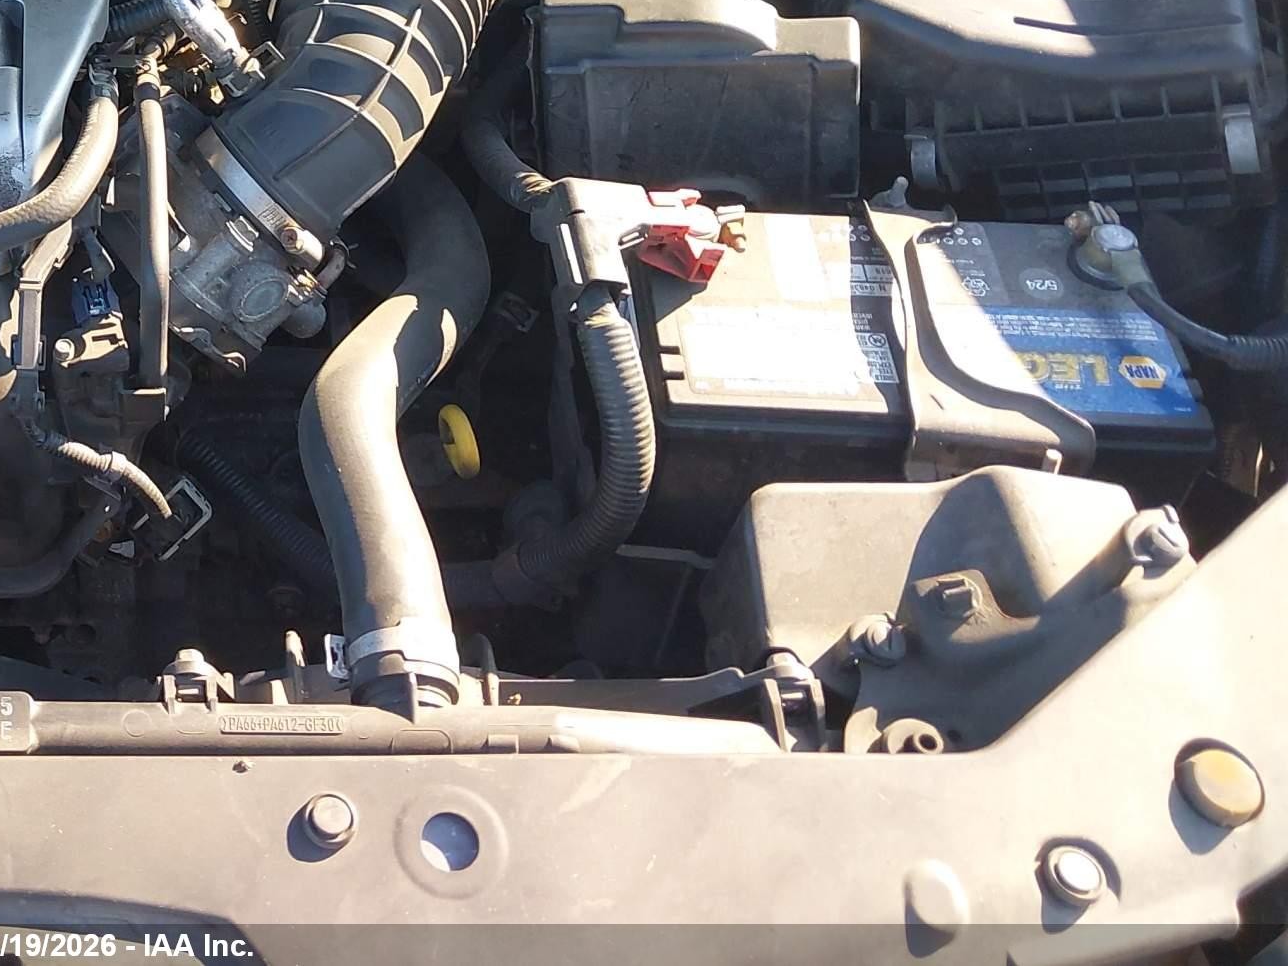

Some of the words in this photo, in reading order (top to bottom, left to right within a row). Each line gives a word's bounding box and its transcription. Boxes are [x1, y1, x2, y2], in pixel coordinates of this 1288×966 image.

[1025, 279, 1058, 291] 5/24
[1019, 351, 1111, 387] LEG
[1126, 366, 1160, 380] NAPA
[0, 696, 13, 716] 5
